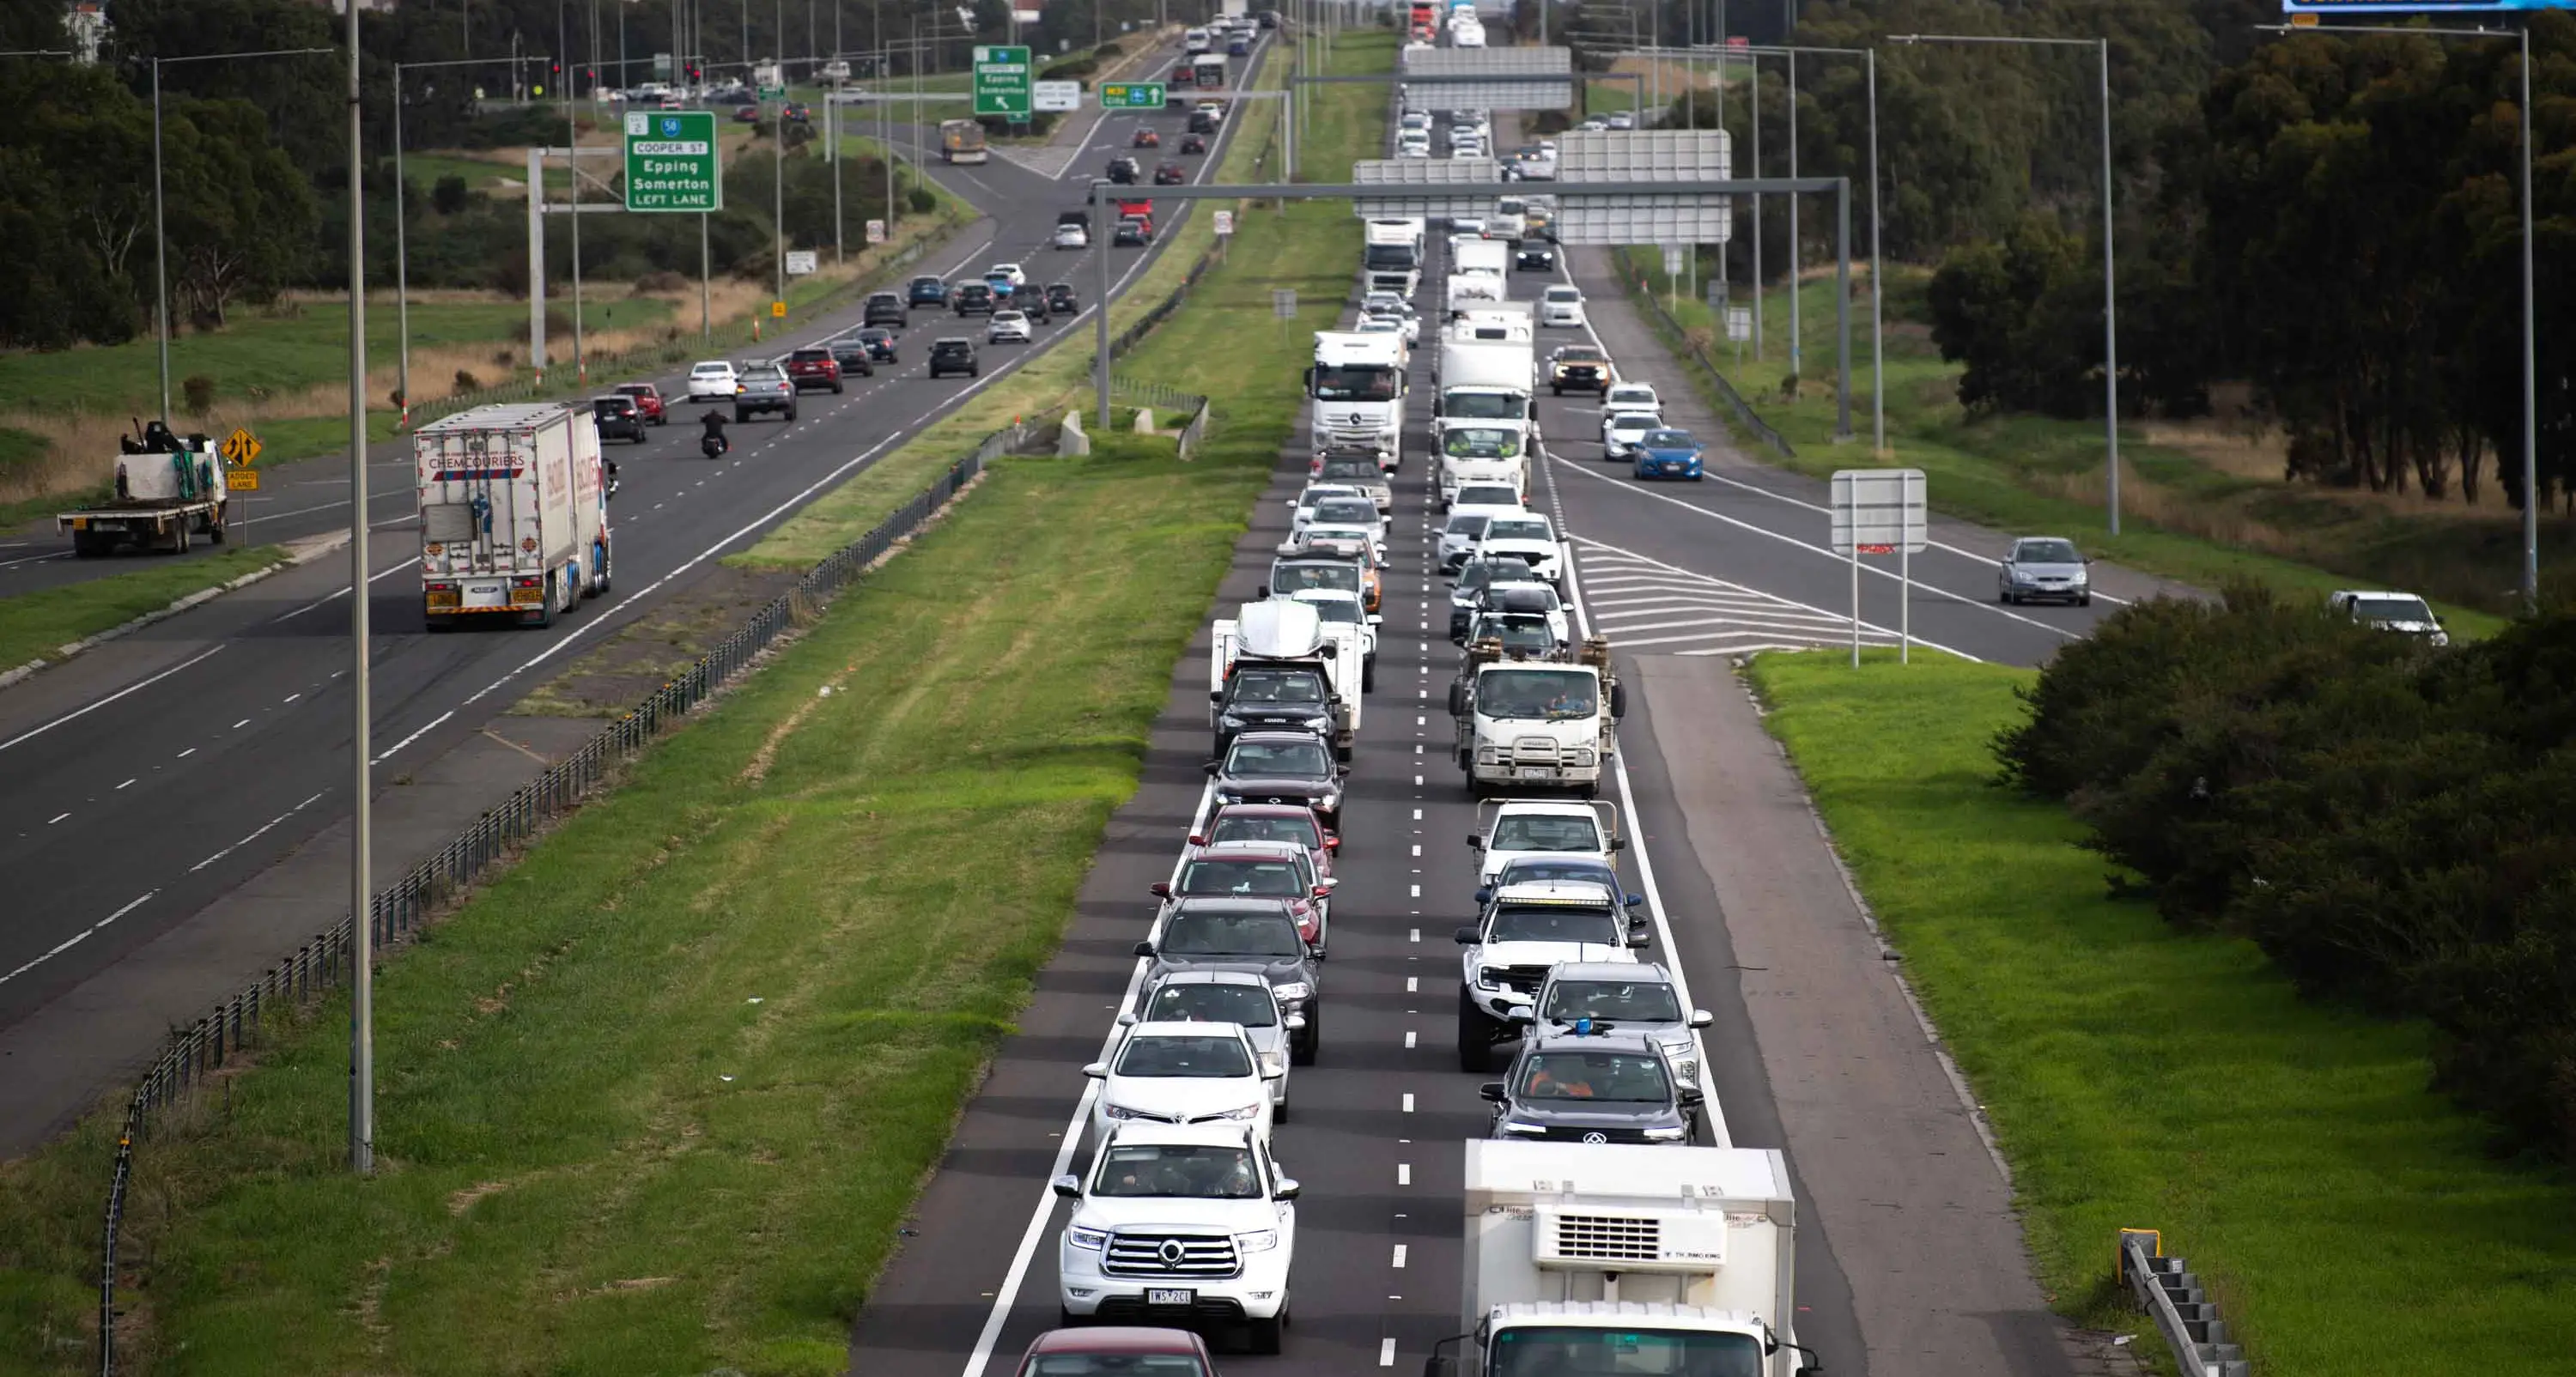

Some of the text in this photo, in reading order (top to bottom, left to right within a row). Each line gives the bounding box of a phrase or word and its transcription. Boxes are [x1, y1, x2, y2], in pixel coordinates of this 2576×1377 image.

[637, 143, 703, 153] COOPER ST
[644, 160, 698, 175] Epping
[634, 178, 709, 190] Somerton
[635, 195, 708, 204] LEFT LANE
[429, 455, 525, 469] CHEMCOURIERS
